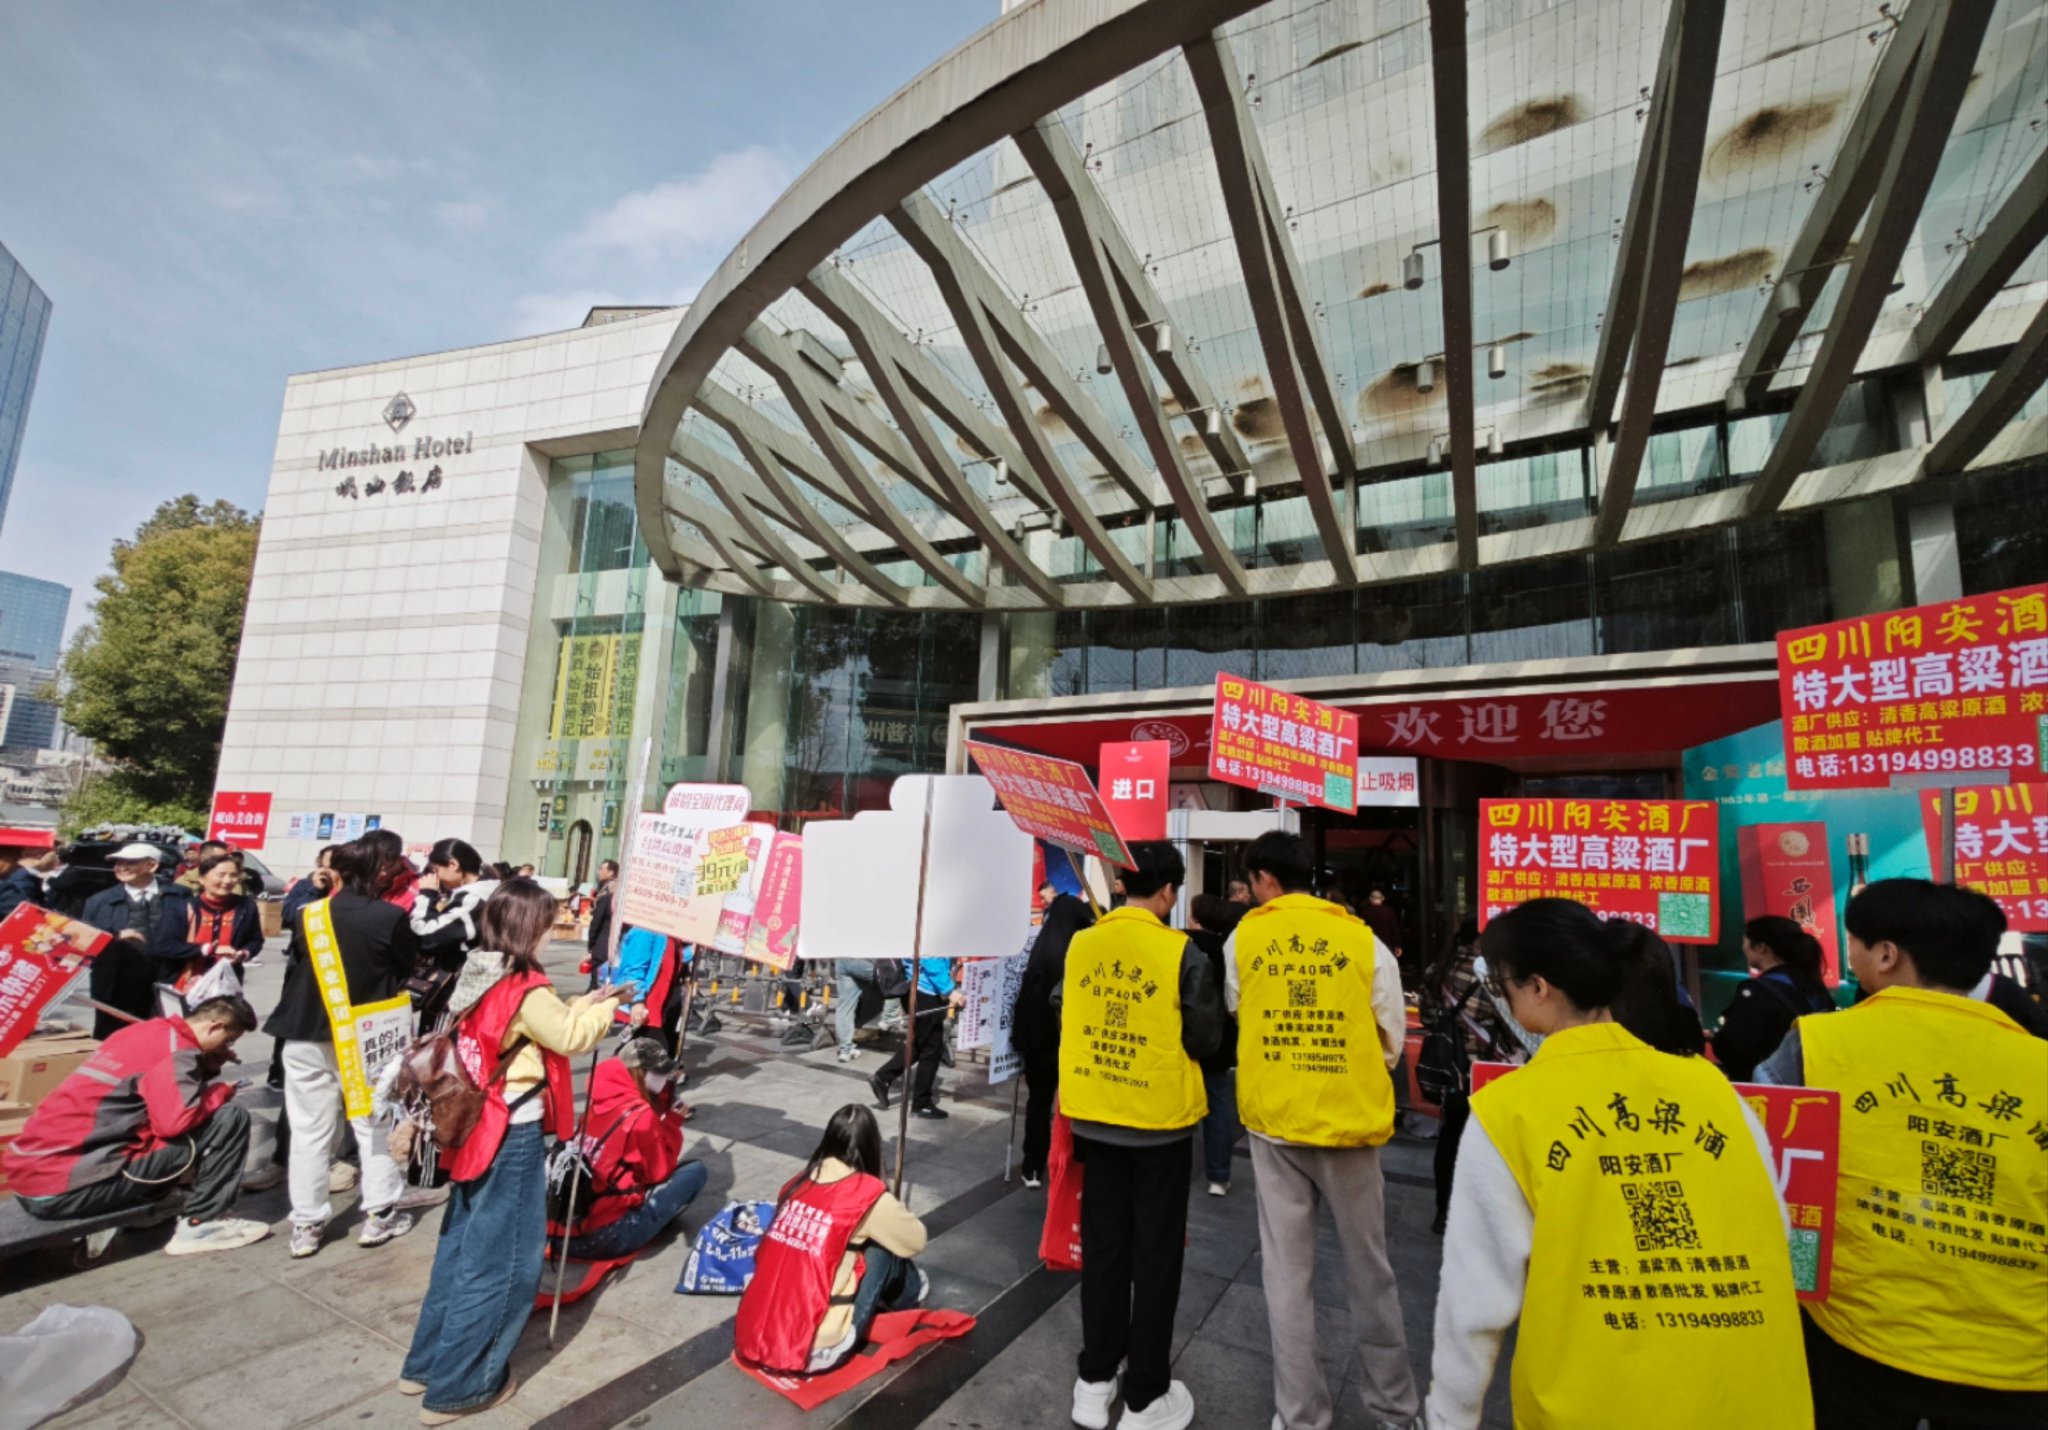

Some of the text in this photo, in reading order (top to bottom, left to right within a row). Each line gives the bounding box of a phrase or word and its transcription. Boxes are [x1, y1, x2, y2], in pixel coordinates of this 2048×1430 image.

[318, 431, 473, 471] Minshan Hotel
[1222, 681, 1354, 733] 四川阳安酒厂
[1382, 697, 1609, 747] 欢迎您
[1221, 701, 1353, 760] 特大型高粱酒厂
[1112, 778, 1155, 800] 进口
[1361, 771, 1415, 792] 止吸烟
[1488, 799, 1710, 833] 四川阳安酒厂
[1489, 832, 1709, 872] 特大型高粱酒厂
[1908, 1114, 2009, 1148] 阳安酒厂
[1599, 1152, 1684, 1176] 阳安酒厂
